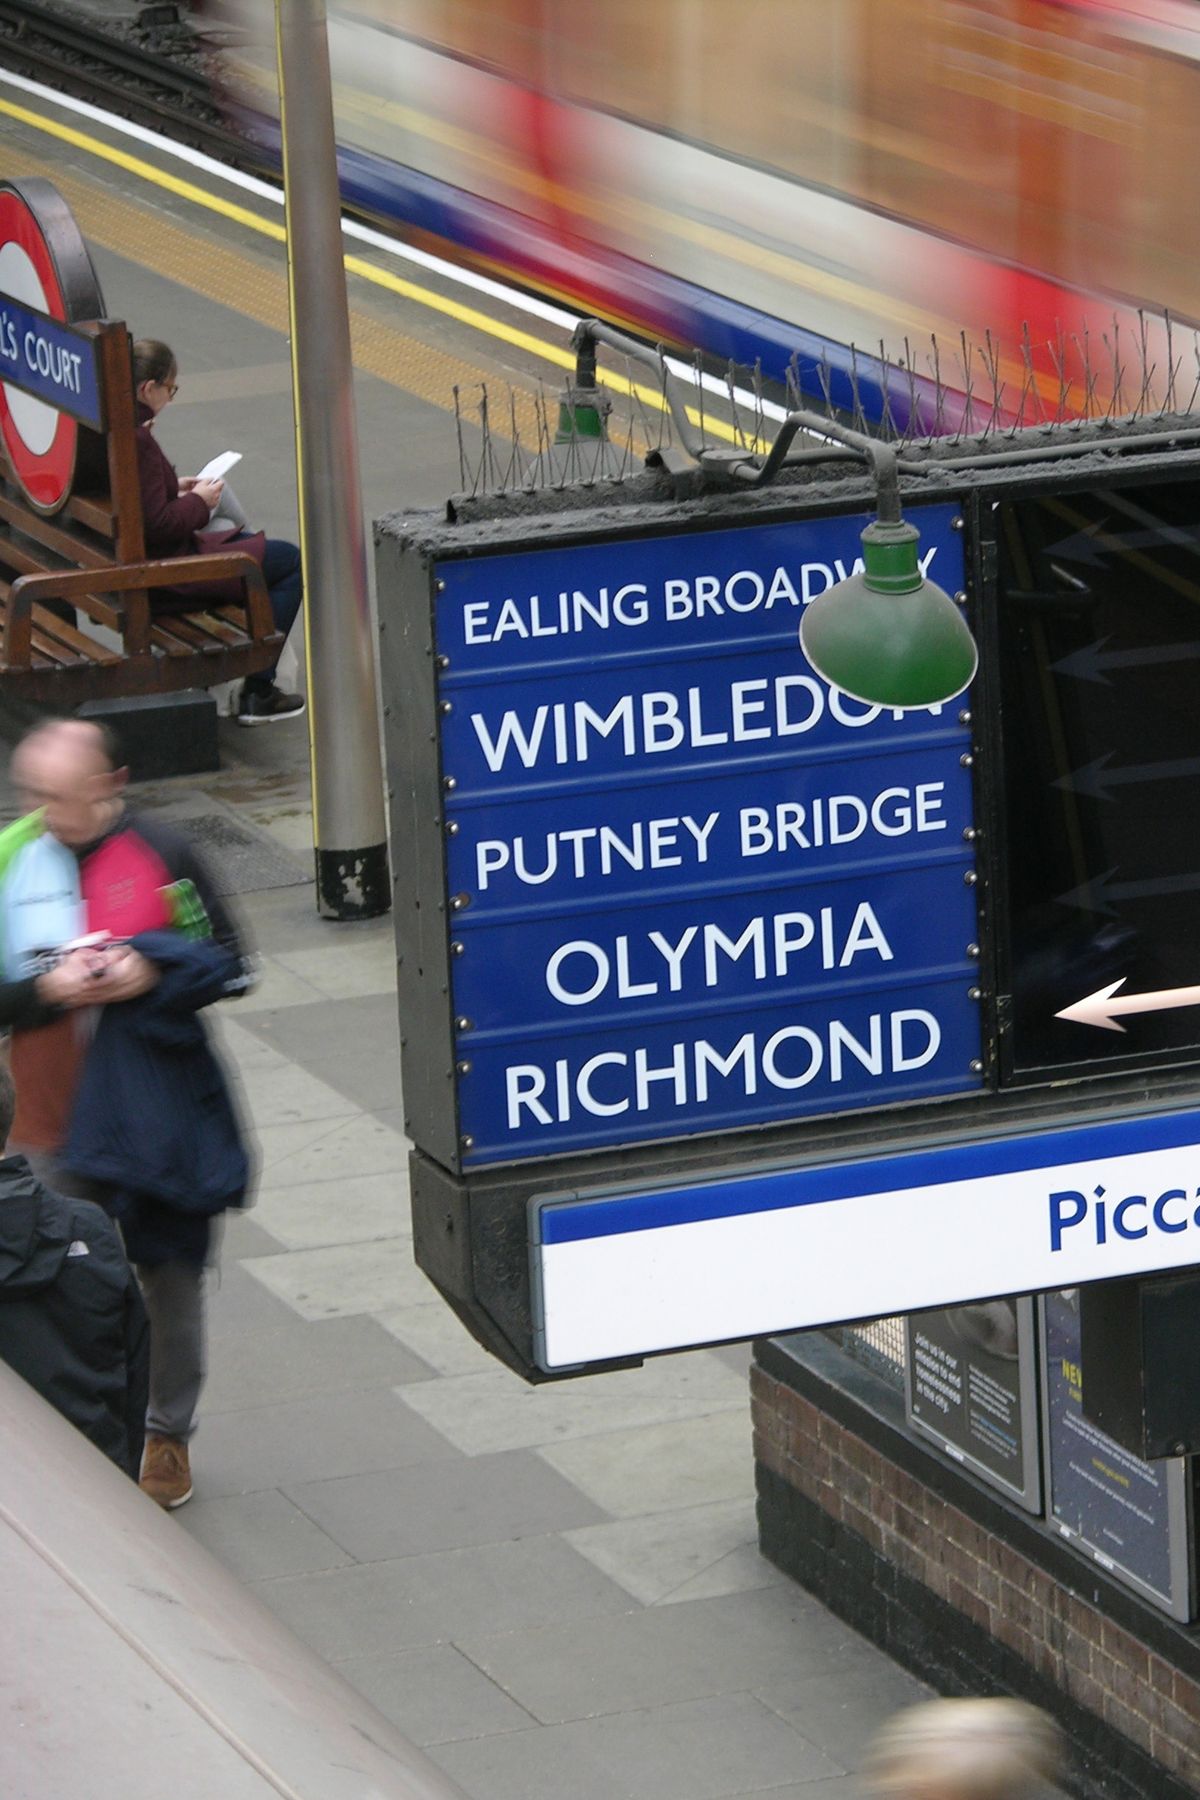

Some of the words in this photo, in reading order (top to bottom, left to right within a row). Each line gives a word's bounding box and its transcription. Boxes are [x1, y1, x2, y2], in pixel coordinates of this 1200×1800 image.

[26, 332, 81, 392] COURT
[464, 584, 648, 644] EALING
[477, 813, 719, 890] PUTNEY
[740, 782, 946, 856] BRIDGE
[547, 902, 893, 1005] OLYMPIA
[506, 1010, 940, 1128] RICHMOND
